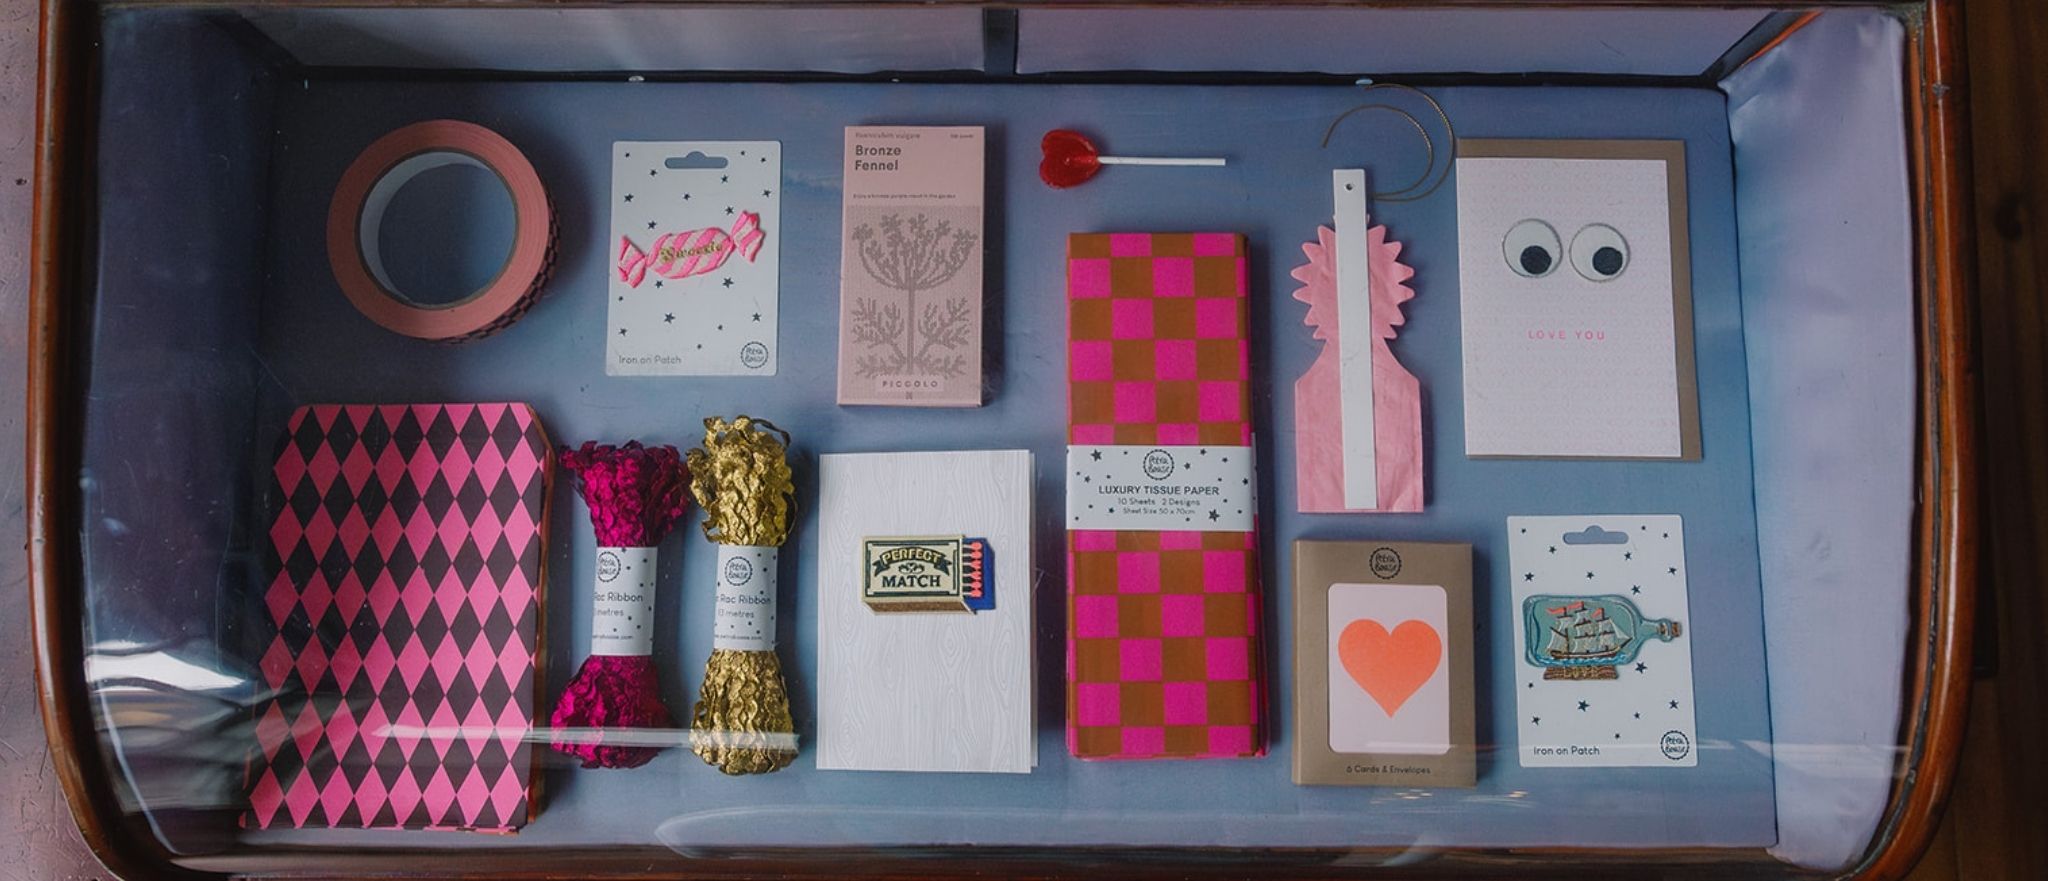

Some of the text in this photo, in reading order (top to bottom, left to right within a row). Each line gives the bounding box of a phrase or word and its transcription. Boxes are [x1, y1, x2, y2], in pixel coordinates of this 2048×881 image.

[855, 144, 902, 156] Bronze
[855, 159, 898, 171] Fennel
[1528, 330, 1605, 340] LOVE YOU
[618, 355, 638, 364] Iron
[654, 354, 682, 364] Patch
[882, 380, 938, 388] PICCOLO
[1098, 485, 1220, 496] LUXURY TISSUE PAPER
[1162, 498, 1167, 506] 2
[1169, 498, 1200, 507] Designs
[882, 548, 942, 565] PERFECT
[882, 574, 941, 588] MATCH
[607, 591, 644, 602] Ribbon
[738, 595, 771, 605] Ribbon
[726, 610, 754, 618] metres
[1533, 746, 1553, 755] Iron
[1571, 745, 1600, 755] Patch
[1354, 765, 1380, 773] Cards
[1382, 765, 1388, 773] &
[1390, 765, 1432, 775] Envelopes
